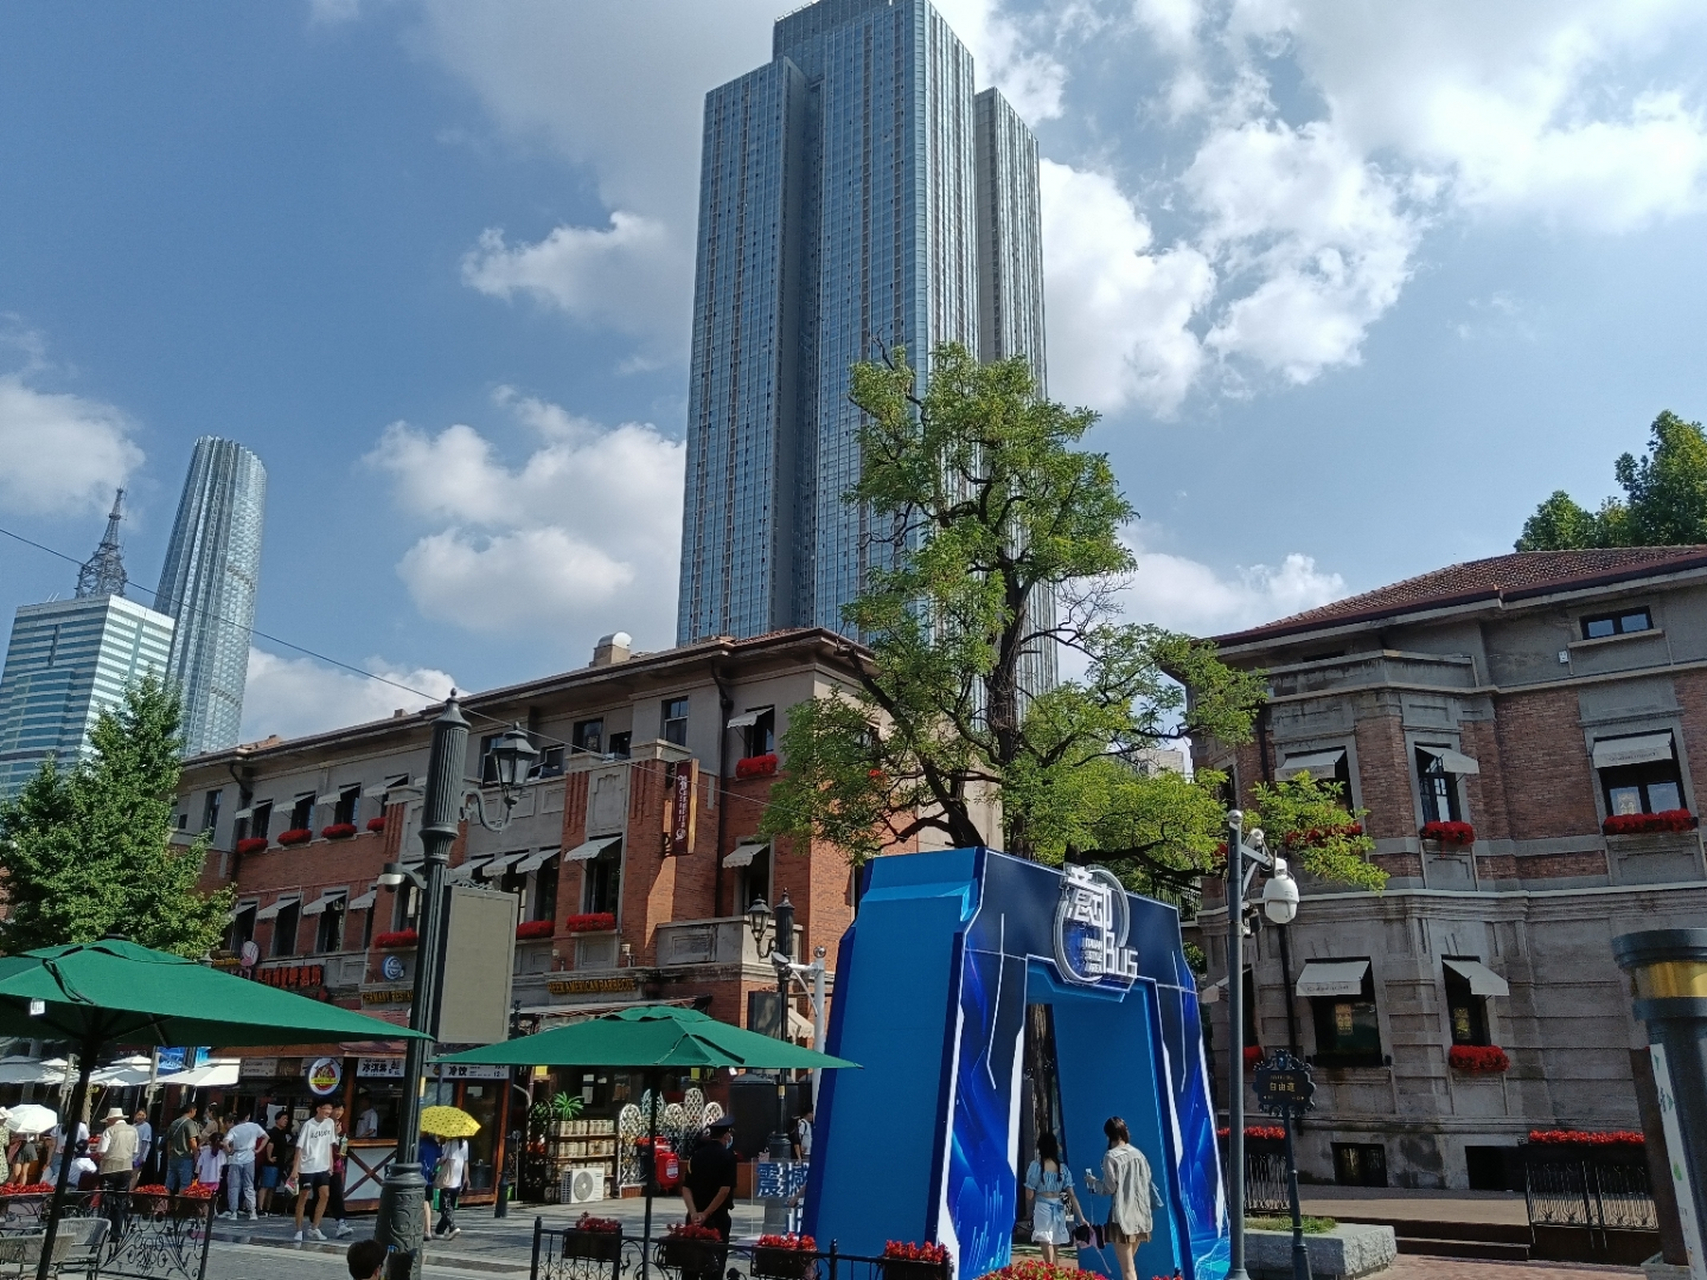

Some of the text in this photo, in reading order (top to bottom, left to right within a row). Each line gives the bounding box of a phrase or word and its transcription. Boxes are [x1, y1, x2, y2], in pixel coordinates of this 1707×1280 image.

[565, 979, 598, 993] AMERICAN
[599, 978, 637, 991] BARBECUE
[391, 990, 413, 1003] RESTA
[448, 1066, 468, 1076] 冷饮
[1269, 1082, 1295, 1093] 自由道
